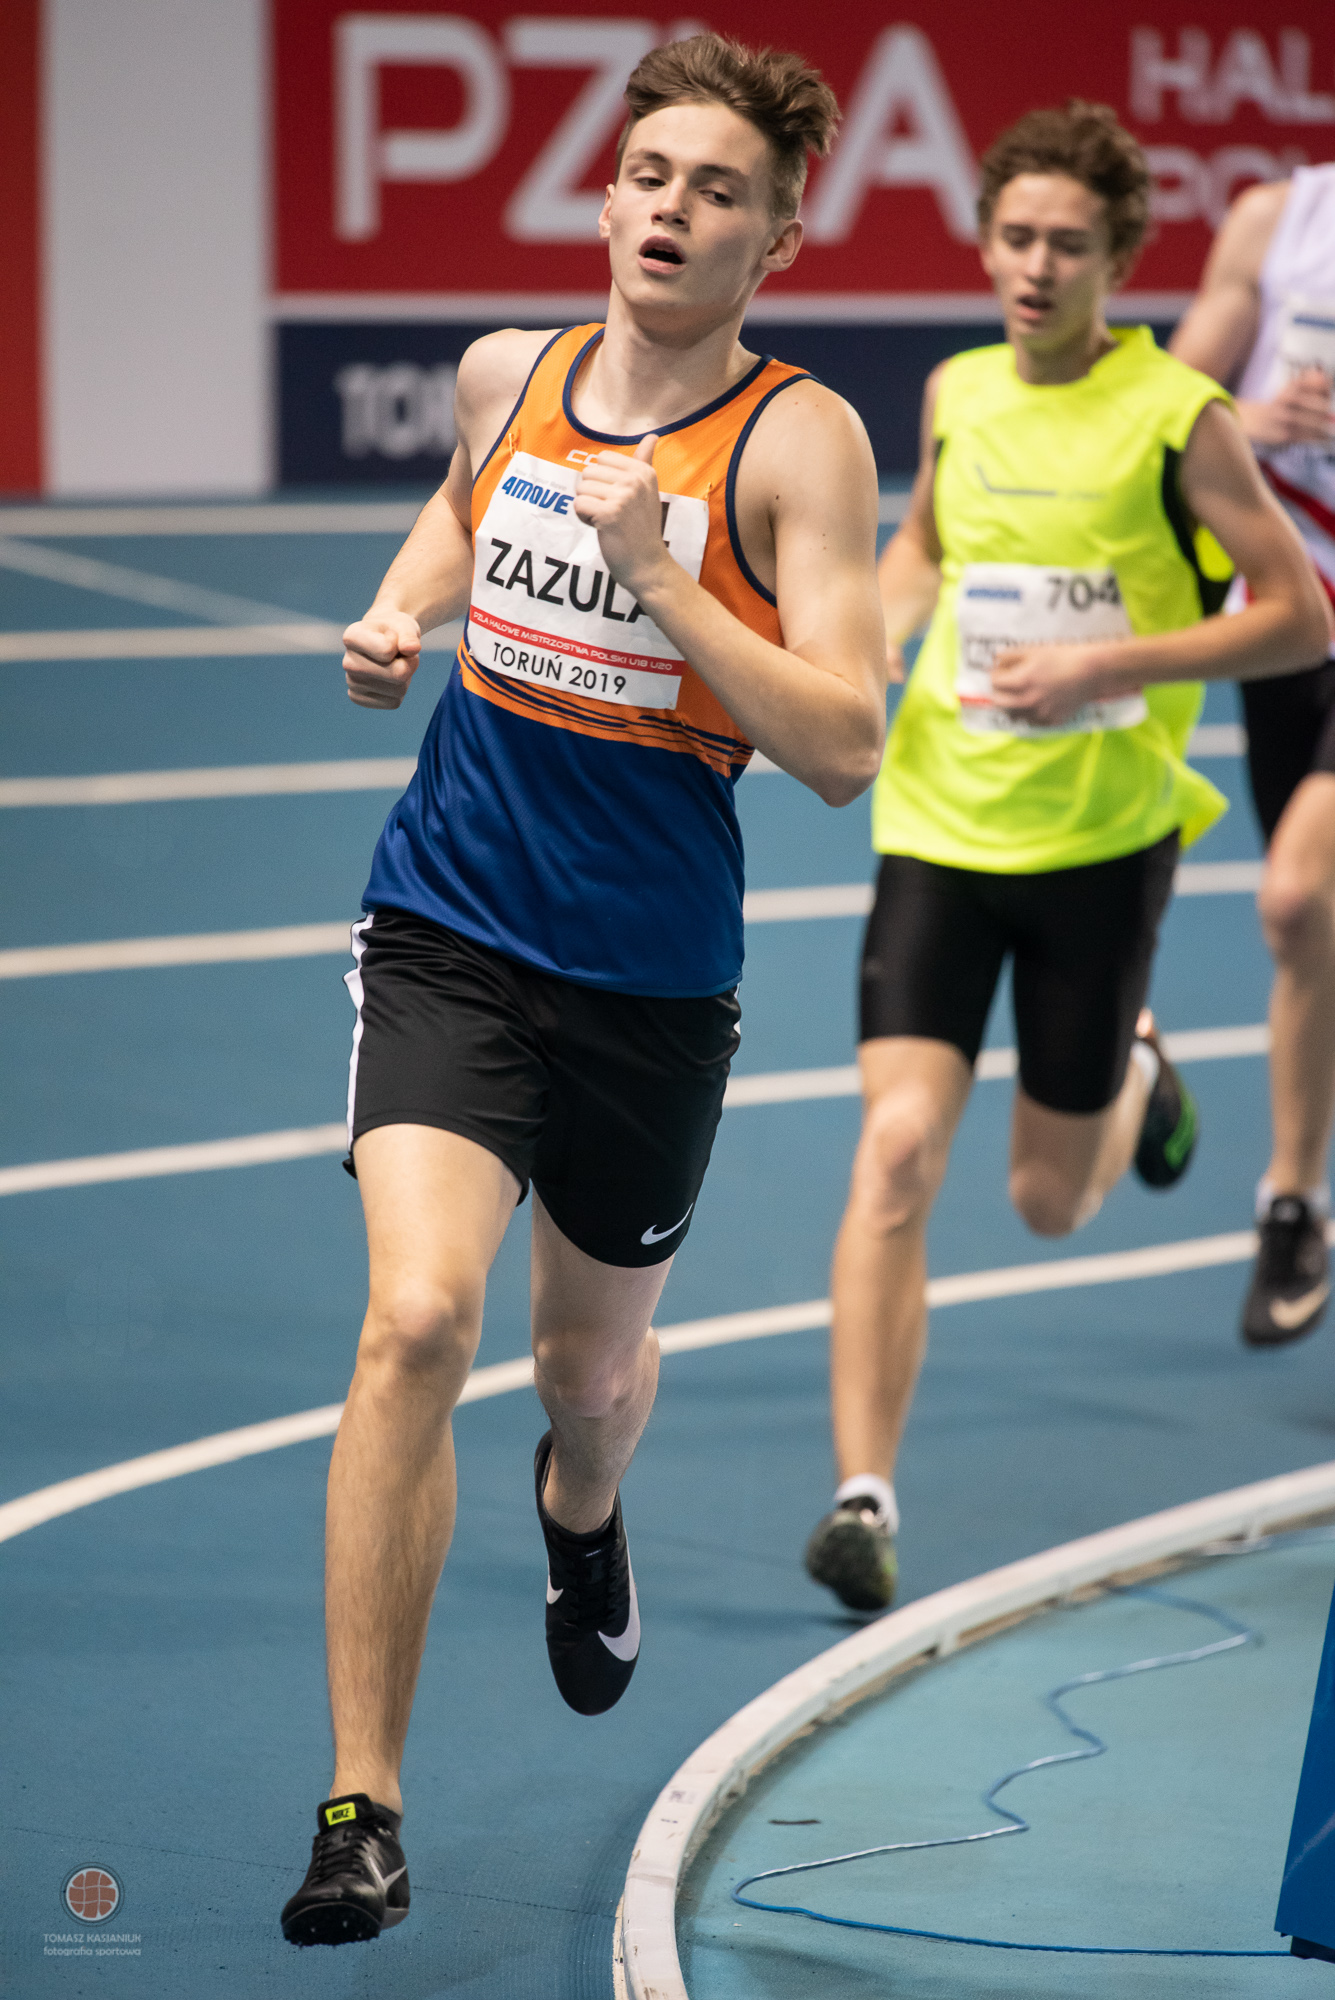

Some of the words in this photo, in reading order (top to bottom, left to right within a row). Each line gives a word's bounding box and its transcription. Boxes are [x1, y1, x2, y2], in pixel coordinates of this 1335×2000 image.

[333, 11, 981, 246] PZA
[1046, 573, 1121, 613] 704
[473, 611, 489, 625] PZLA
[489, 618, 521, 637] HALOWE
[520, 630, 590, 656] MISTRZOSTWA
[590, 649, 628, 664] POLSKI
[629, 657, 649, 668] U18
[650, 660, 673, 671] U20
[493, 641, 563, 682] TORUŃ
[568, 665, 627, 695] 2019
